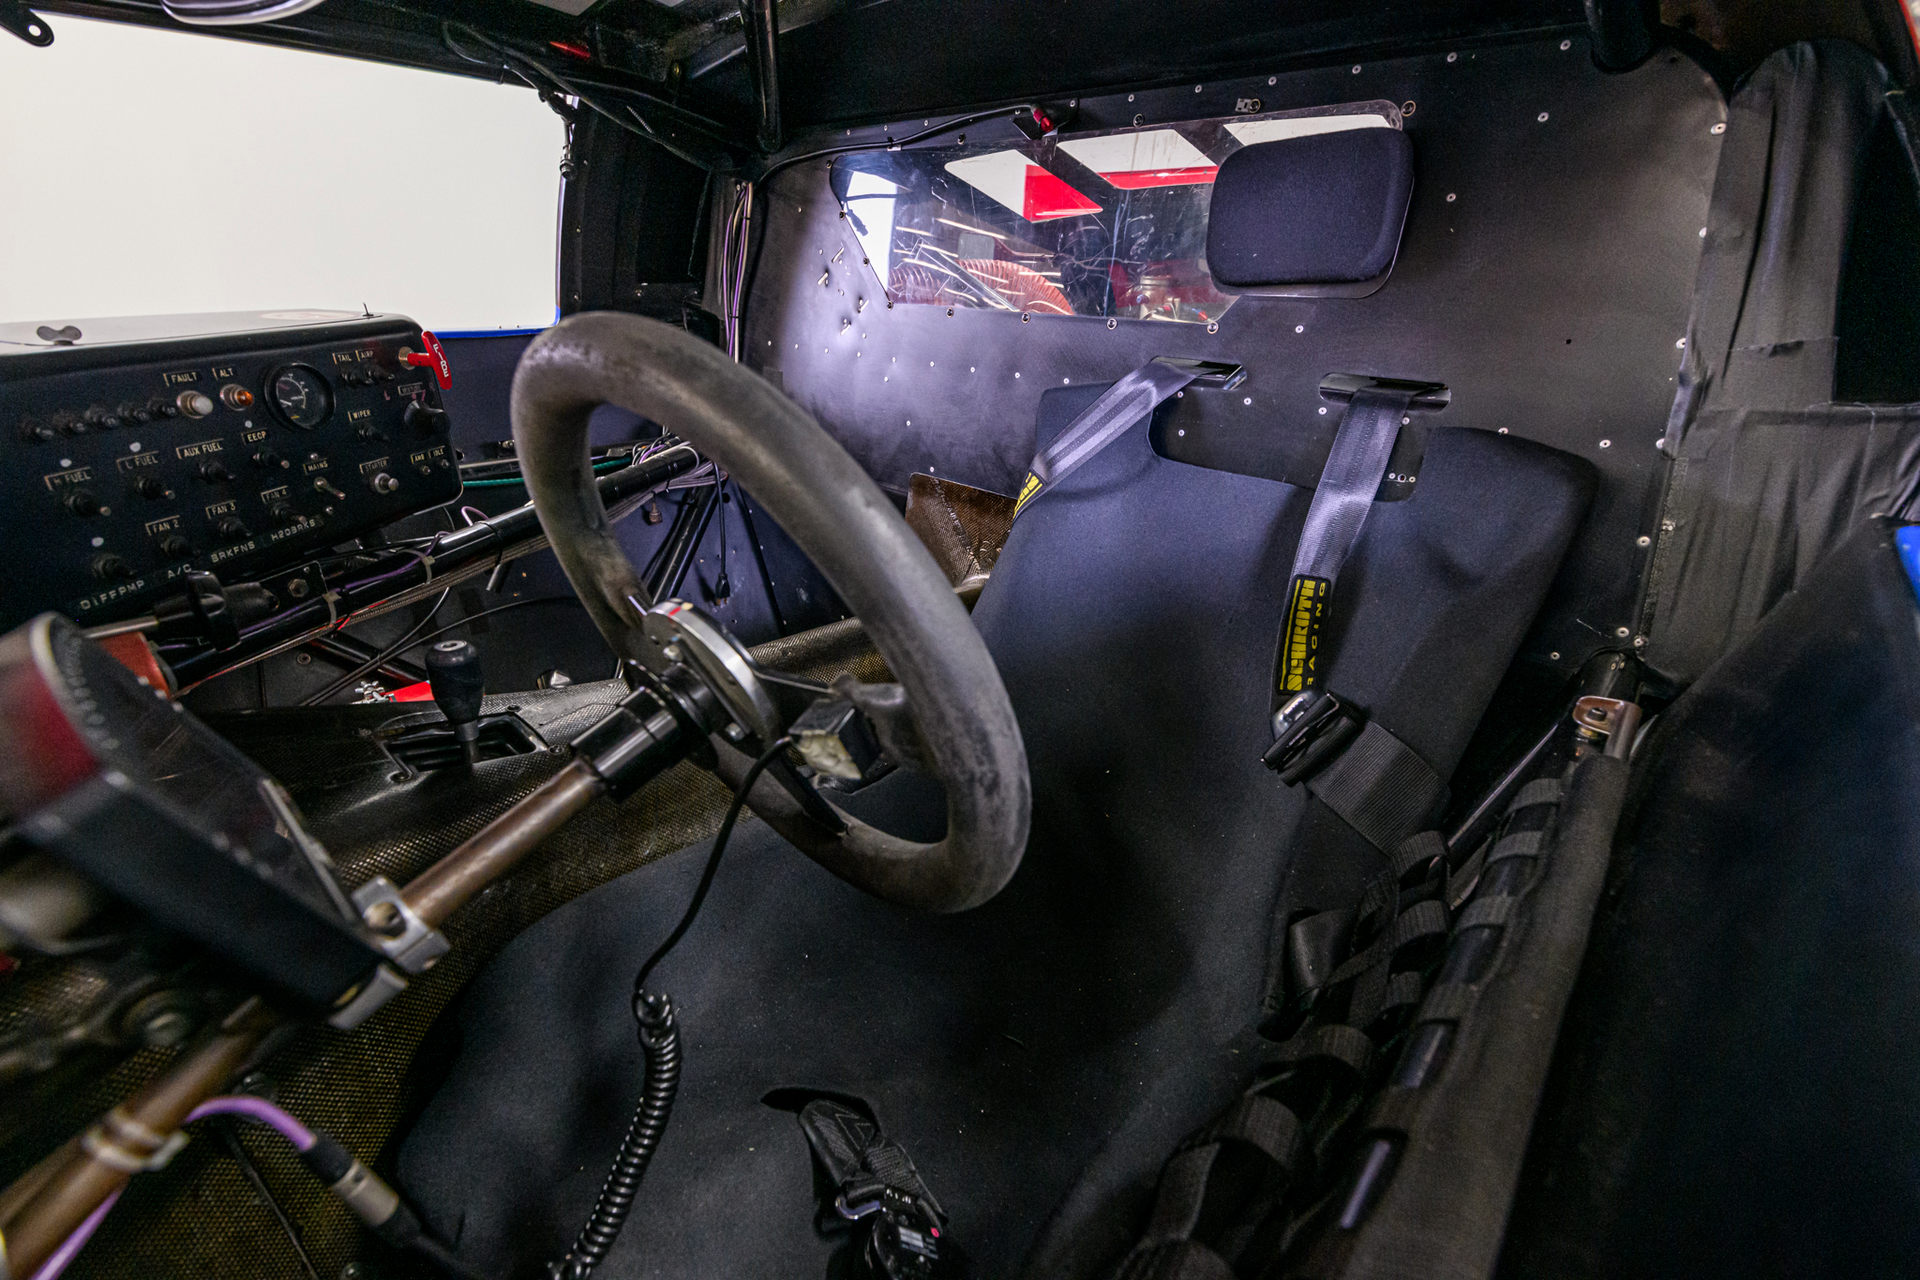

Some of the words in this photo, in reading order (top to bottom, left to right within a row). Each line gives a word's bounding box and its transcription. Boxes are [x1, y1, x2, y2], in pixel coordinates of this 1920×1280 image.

[338, 353, 352, 362] TAIL
[433, 343, 449, 378] FIRE
[171, 372, 197, 383] FAULT
[220, 368, 235, 377] ALT
[352, 409, 371, 419] WIPER
[183, 447, 200, 457] AUX
[201, 442, 223, 454] FUEL
[135, 455, 158, 466] FUEL
[307, 460, 328, 471] MAINS
[365, 460, 387, 472] STARTER
[64, 471, 91, 483] FUEL
[266, 491, 280, 501] FAN
[211, 505, 227, 515] FAN
[230, 501, 236, 511] 3
[152, 521, 170, 533] FAN
[173, 520, 179, 528] 2
[167, 563, 192, 579] A/C
[1286, 579, 1316, 691] SCHROTH
[1306, 582, 1326, 685] RACING
